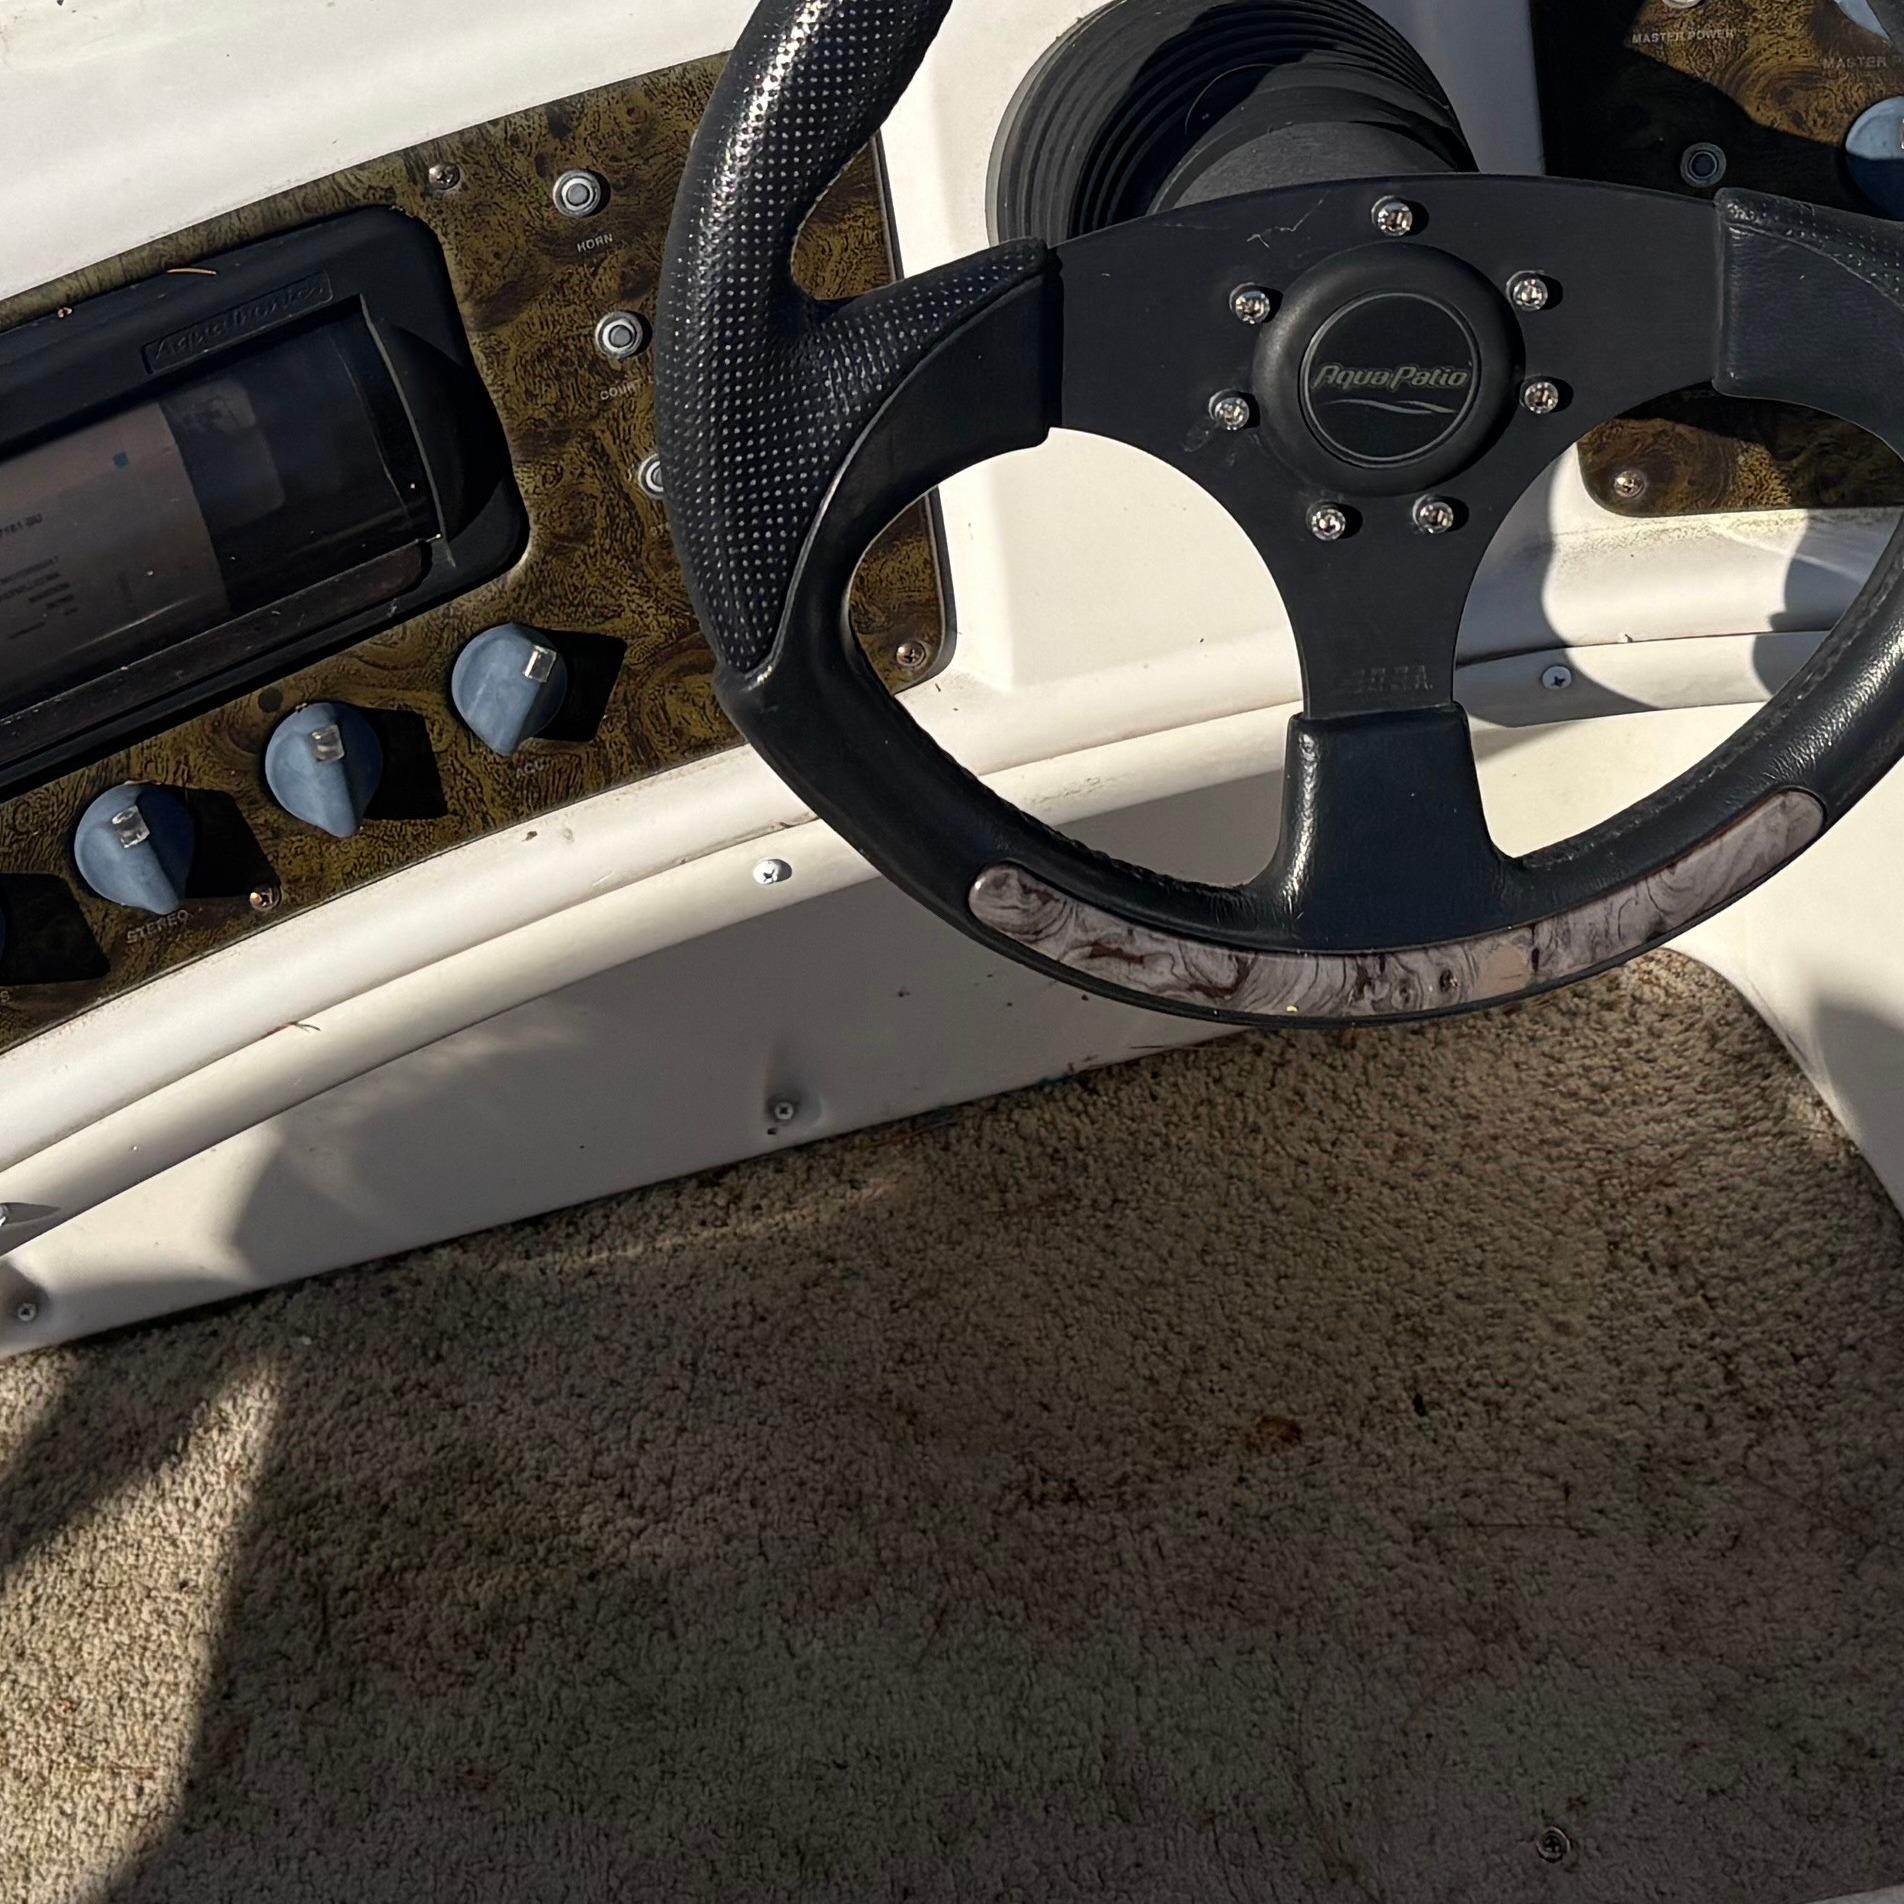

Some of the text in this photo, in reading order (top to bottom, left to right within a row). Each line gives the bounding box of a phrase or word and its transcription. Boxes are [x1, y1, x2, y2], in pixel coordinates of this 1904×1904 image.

[1632, 28, 1735, 44] MASTER POWER
[1822, 55, 1887, 70] MASTER
[576, 233, 614, 253] HORN
[1310, 364, 1472, 392] AquaPatio
[126, 909, 189, 944] STEREO
